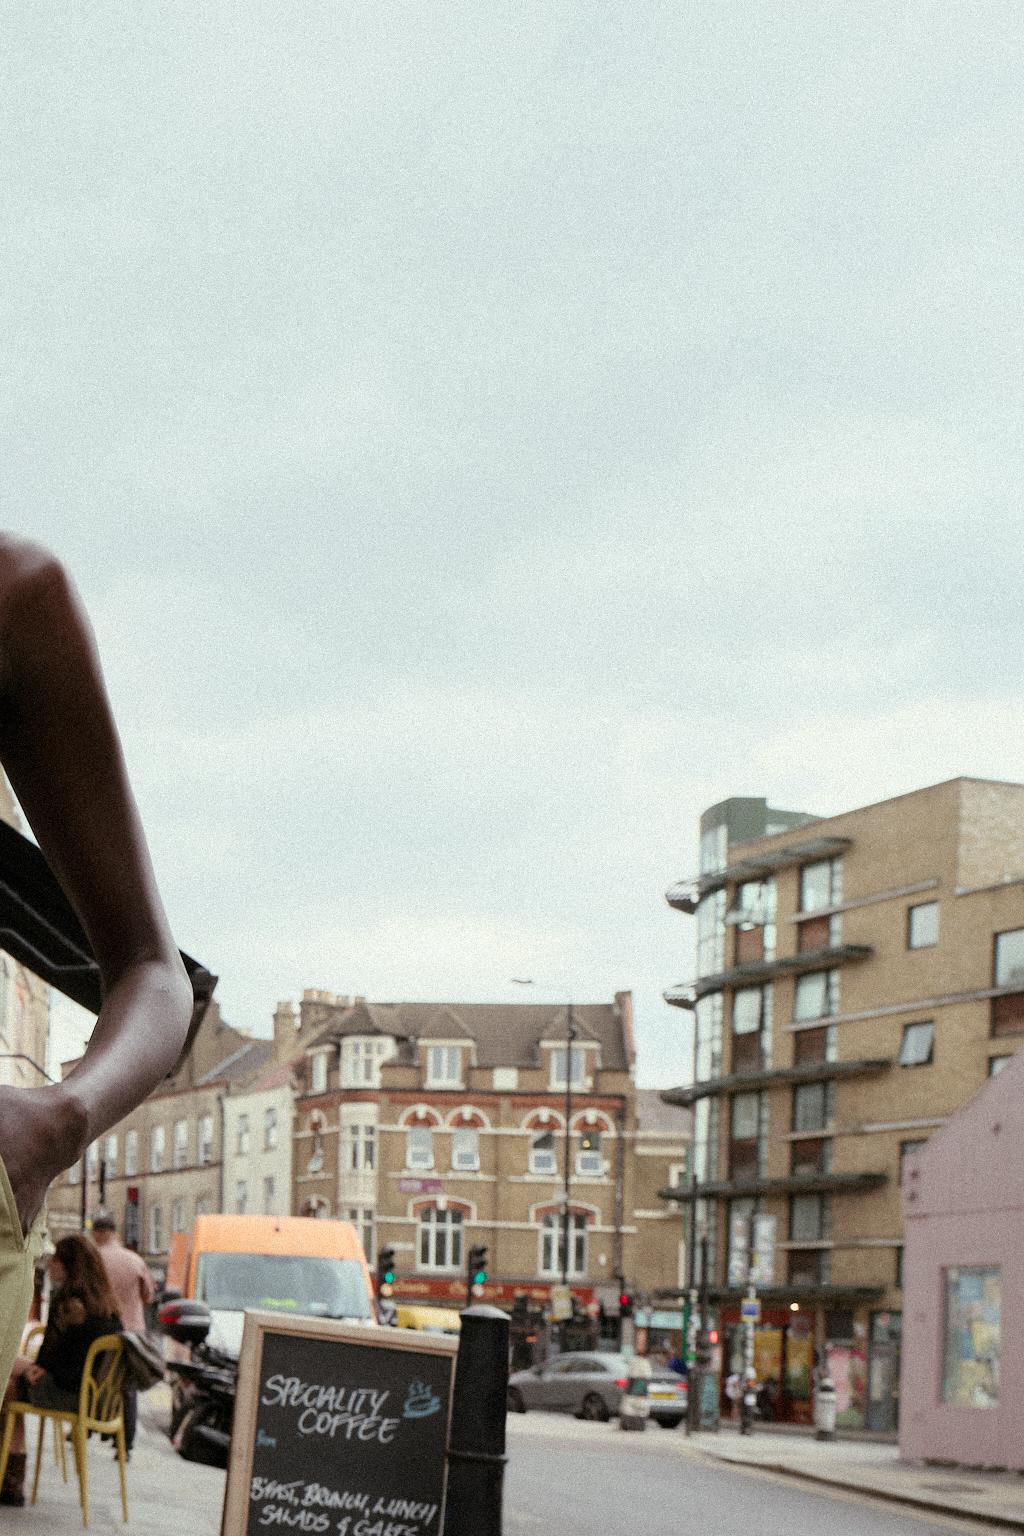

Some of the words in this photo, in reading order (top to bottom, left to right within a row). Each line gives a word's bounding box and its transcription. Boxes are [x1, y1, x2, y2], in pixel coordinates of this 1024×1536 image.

[262, 1374, 391, 1420] SPECIALITY
[298, 1408, 401, 1444] COFFEE
[258, 1504, 331, 1533] SALADS
[372, 1497, 438, 1527] LUNCH
